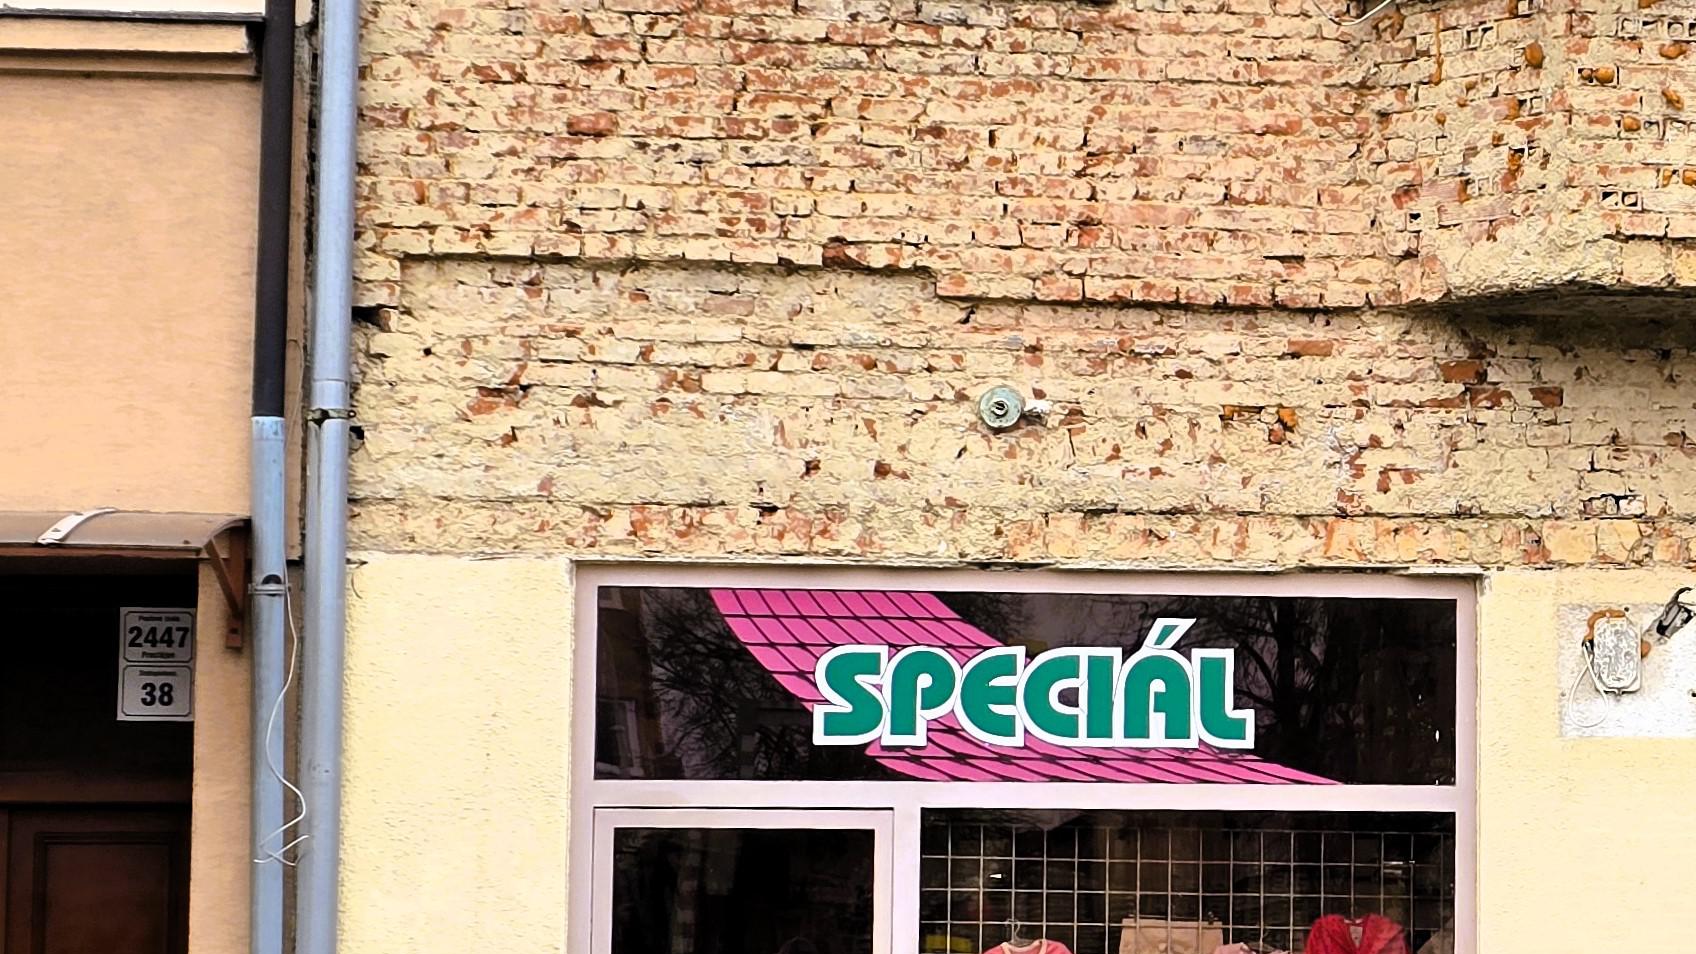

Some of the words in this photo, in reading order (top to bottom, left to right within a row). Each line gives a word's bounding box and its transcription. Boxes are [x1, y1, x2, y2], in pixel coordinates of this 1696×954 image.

[128, 626, 190, 648] 2447
[141, 682, 173, 706] 38
[813, 618, 1255, 748] SPECIÁL
